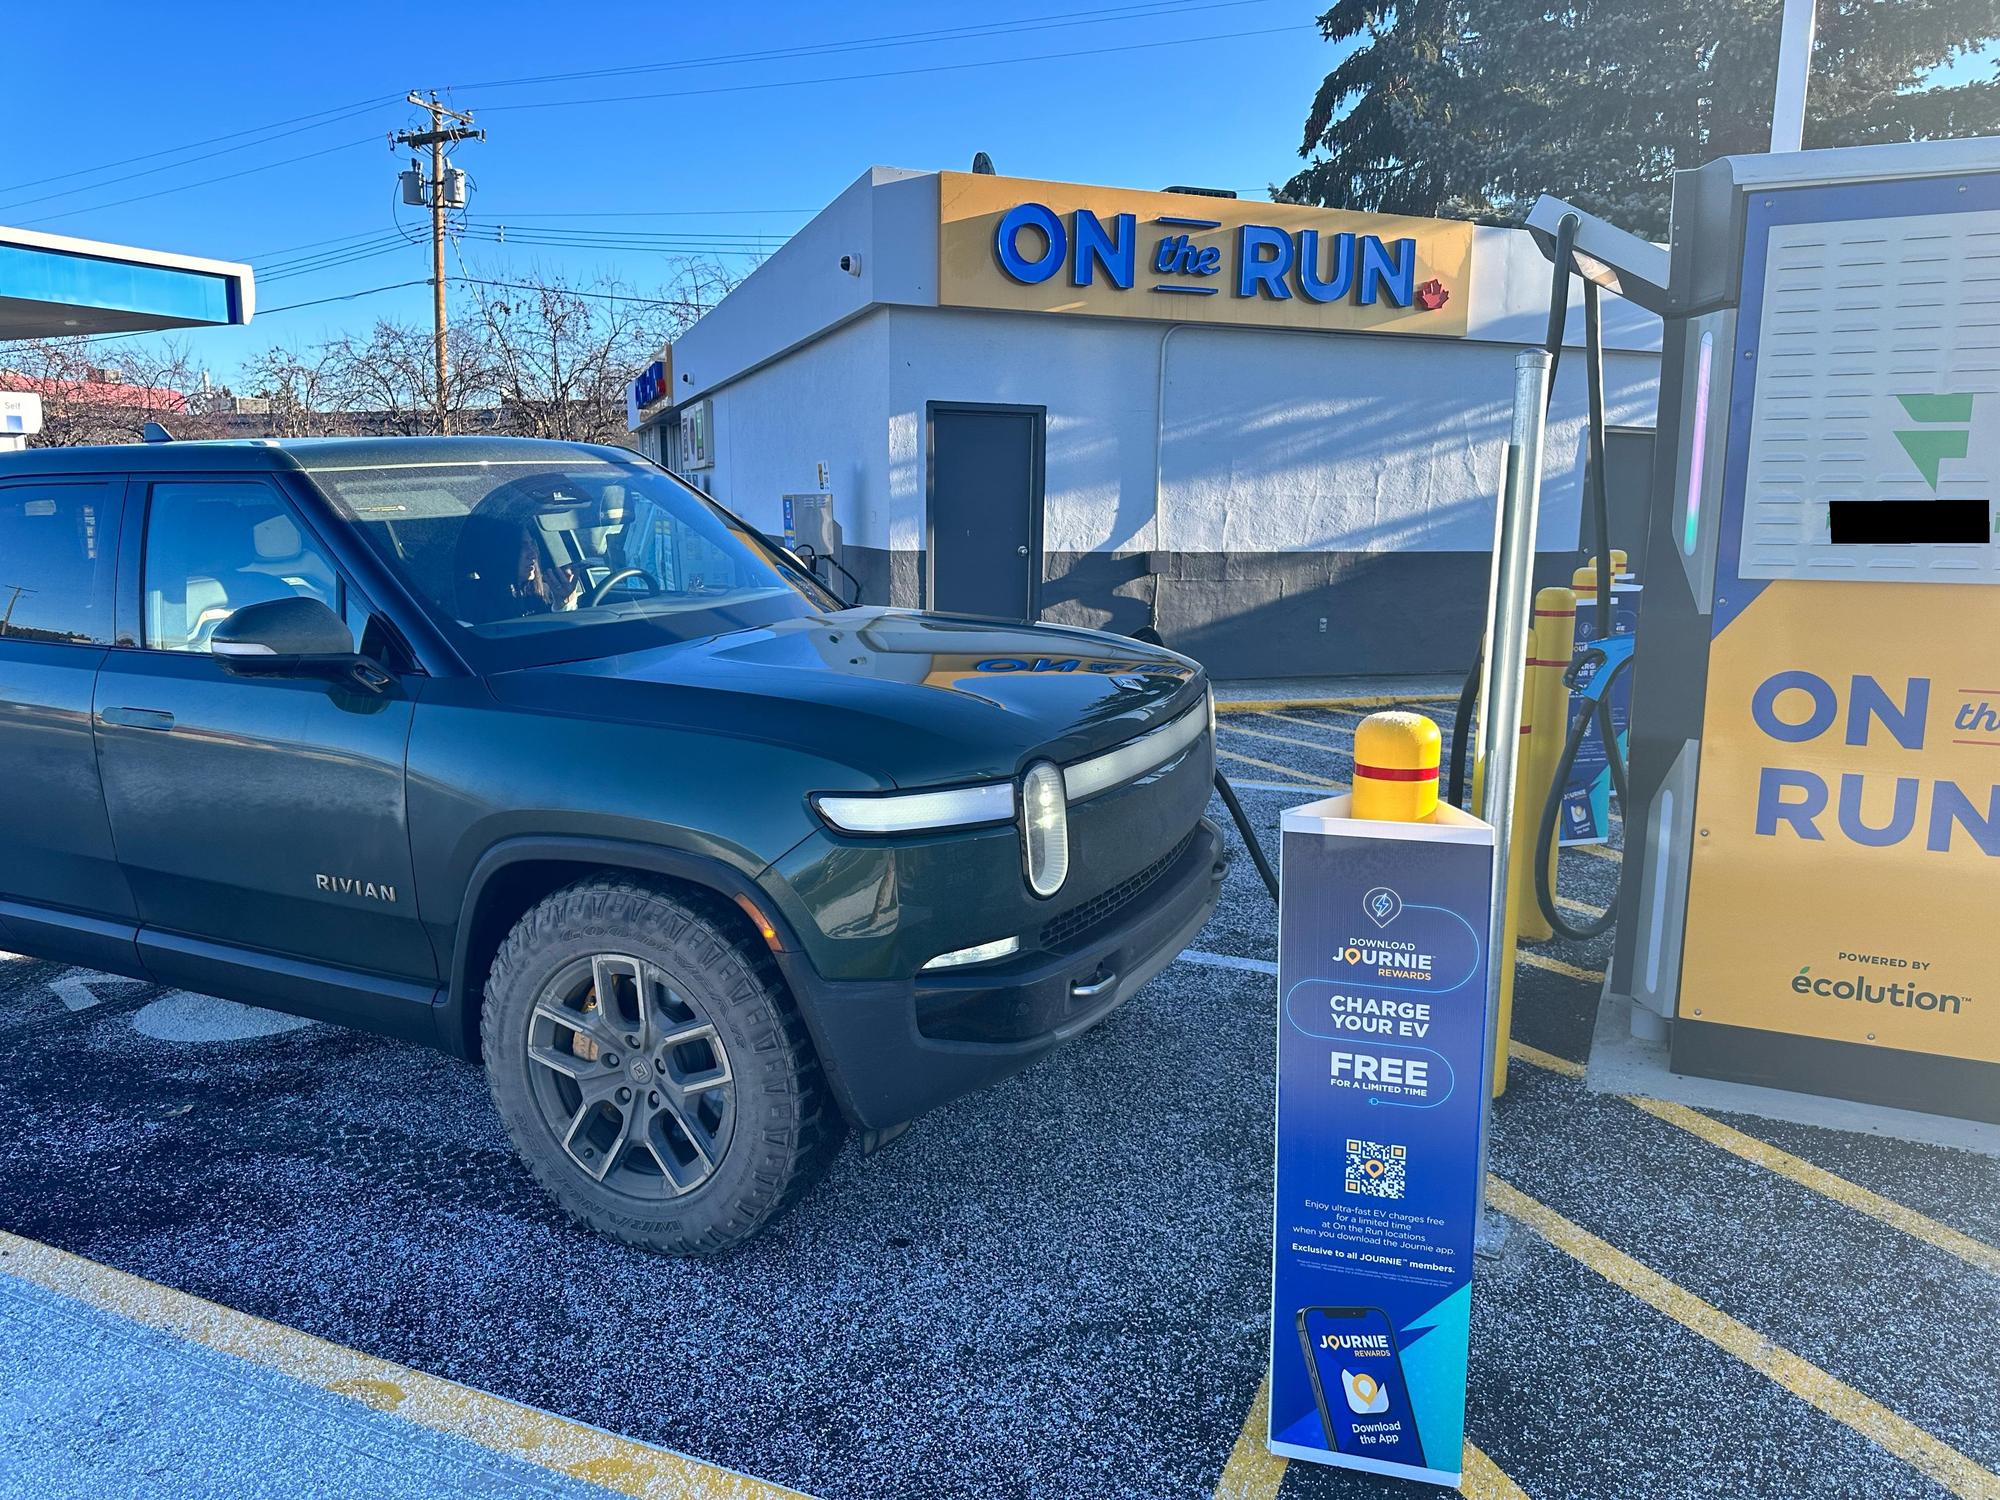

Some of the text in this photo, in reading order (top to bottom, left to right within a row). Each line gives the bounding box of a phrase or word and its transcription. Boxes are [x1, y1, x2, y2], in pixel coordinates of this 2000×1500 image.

[994, 202, 1418, 308] ON the RUN
[4, 401, 21, 410] Self
[1751, 670, 2000, 750] ON th
[1755, 767, 2000, 858] RUN
[315, 873, 397, 903] RIVIAN
[1349, 937, 1416, 951] DOWNLOAD
[1838, 952, 1931, 971] POWERED BY
[1378, 968, 1432, 981] REWARDS
[1330, 995, 1431, 1021] CHARGE
[1331, 1014, 1430, 1038] YOUR EV
[1330, 1051, 1428, 1087] FREE
[1330, 1078, 1350, 1088] FOR
[1362, 1083, 1401, 1094] LIMITED
[1403, 1087, 1428, 1097] TIME
[1305, 1199, 1445, 1226] Enjoy ultra-fast EV charges free
[1336, 1213, 1348, 1222] for
[1358, 1217, 1389, 1228] limited
[1391, 1221, 1412, 1231] time
[1292, 1226, 1456, 1256] when you download the Journie app.
[1321, 1221, 1426, 1242] at On the Run locations
[1292, 1243, 1333, 1256] Exclusive
[1335, 1250, 1345, 1258] to
[1346, 1252, 1358, 1260] all
[1409, 1261, 1456, 1273] members.
[1319, 1333, 1390, 1351] JOURNIE
[1353, 1349, 1391, 1358] REWARDS
[1351, 1421, 1401, 1434] Download
[1359, 1433, 1399, 1445] the App
